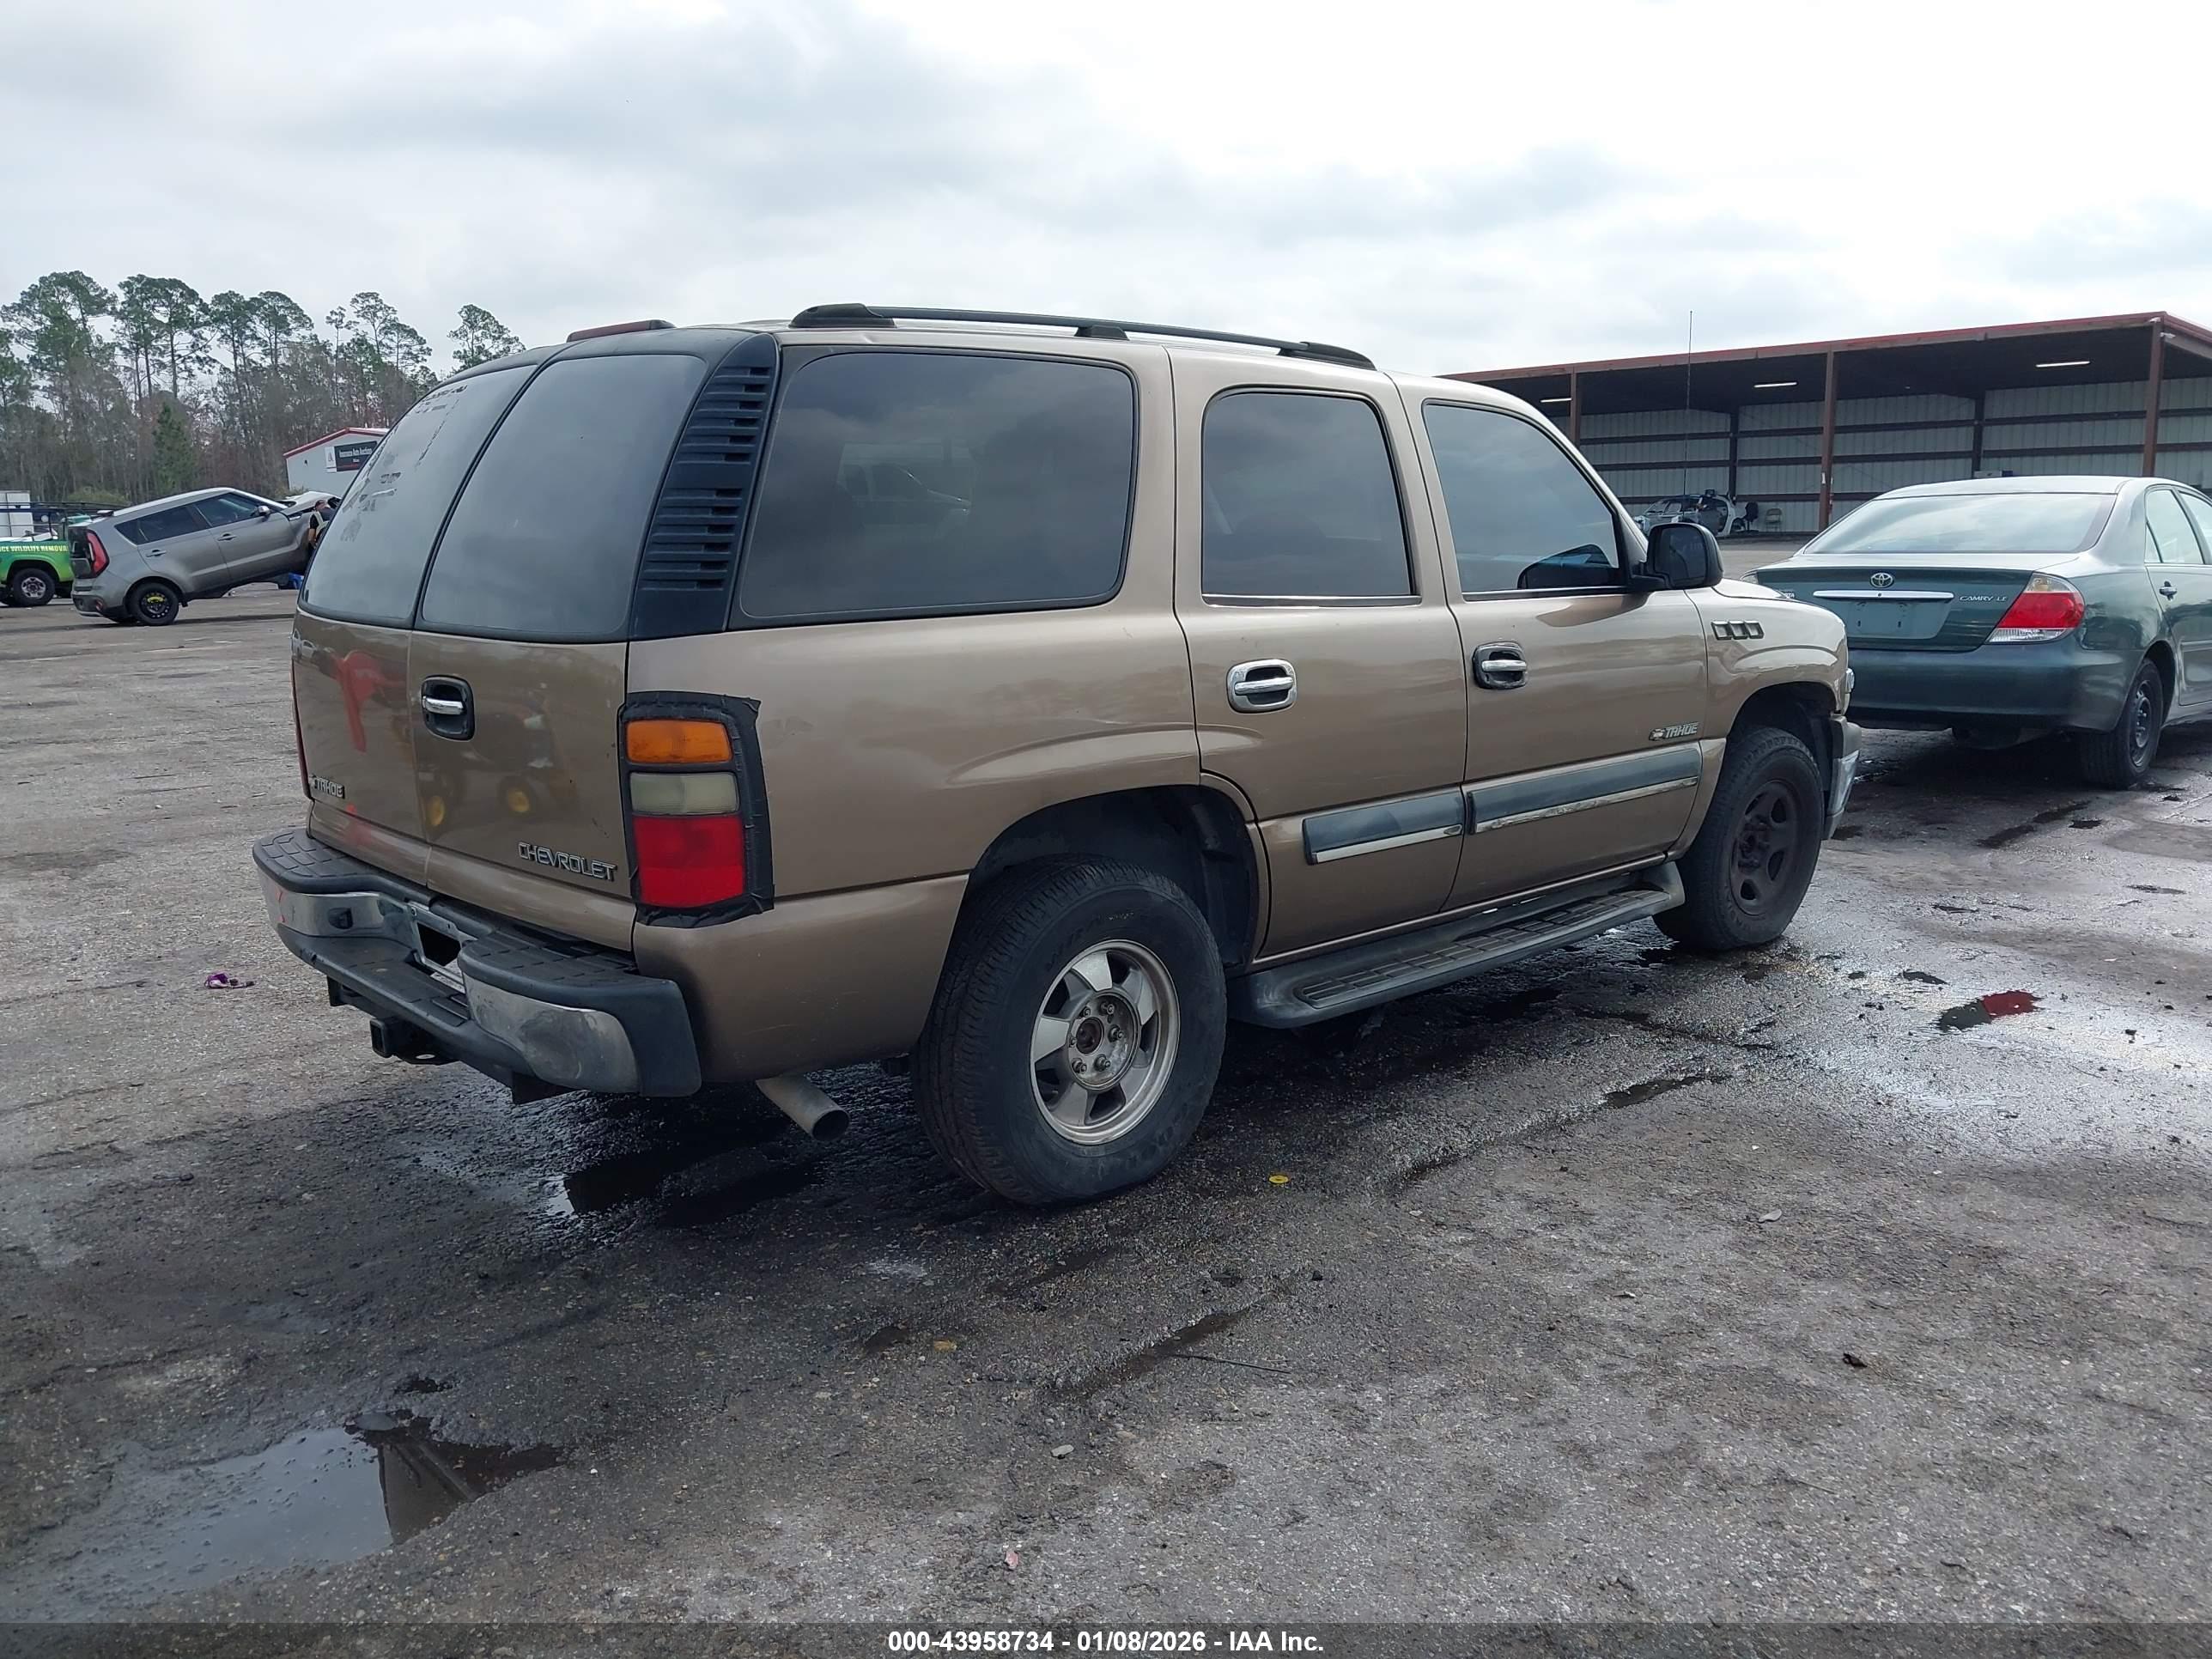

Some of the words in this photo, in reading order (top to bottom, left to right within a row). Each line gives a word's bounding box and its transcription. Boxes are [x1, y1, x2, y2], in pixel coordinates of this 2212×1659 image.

[1665, 722, 1698, 738] TAHOE
[316, 777, 343, 798] TAHOE
[518, 842, 617, 880] CHEVROLET
